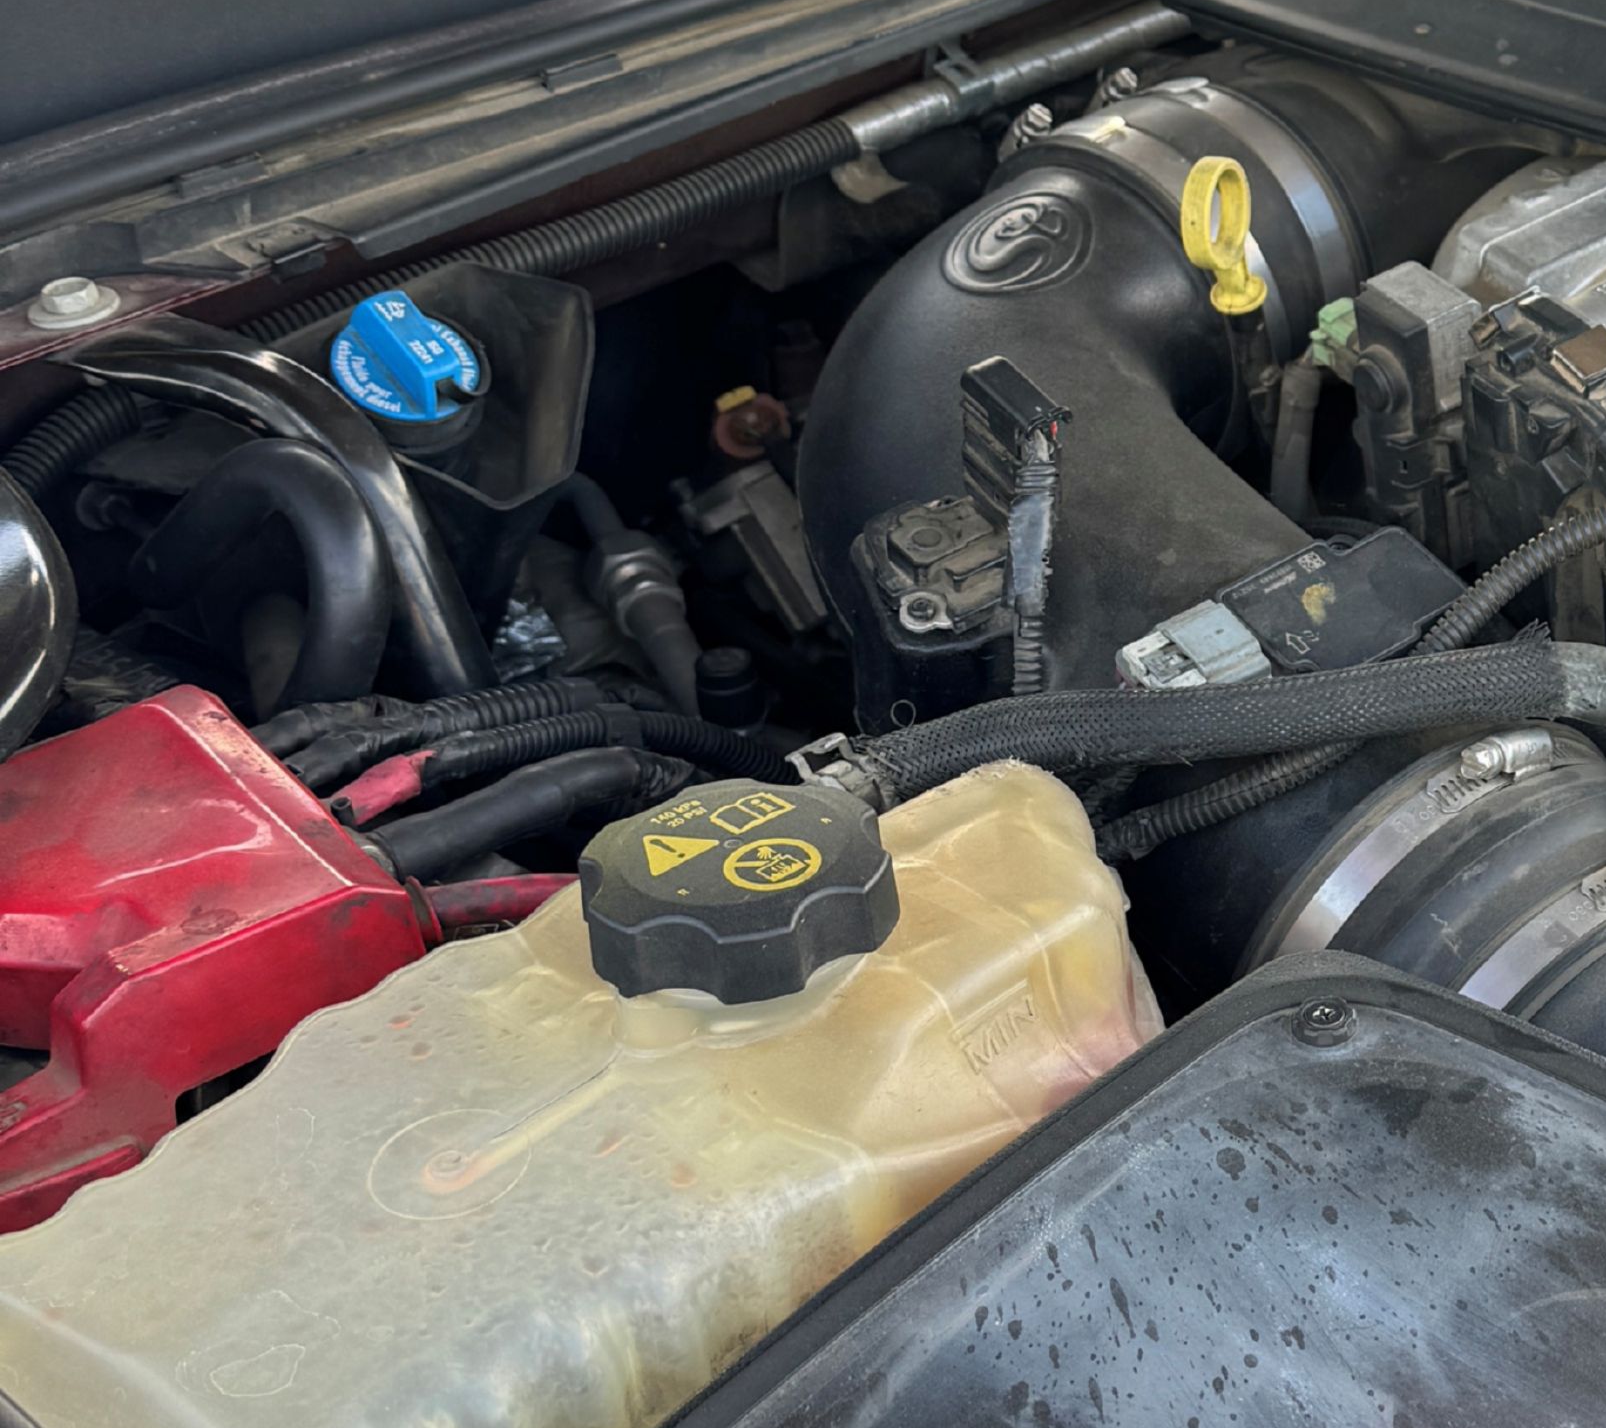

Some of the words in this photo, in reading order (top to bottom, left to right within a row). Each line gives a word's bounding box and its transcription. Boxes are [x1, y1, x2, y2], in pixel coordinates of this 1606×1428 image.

[650, 811, 677, 825] 140
[667, 817, 685, 829] 20
[963, 993, 1038, 1074] MIN
